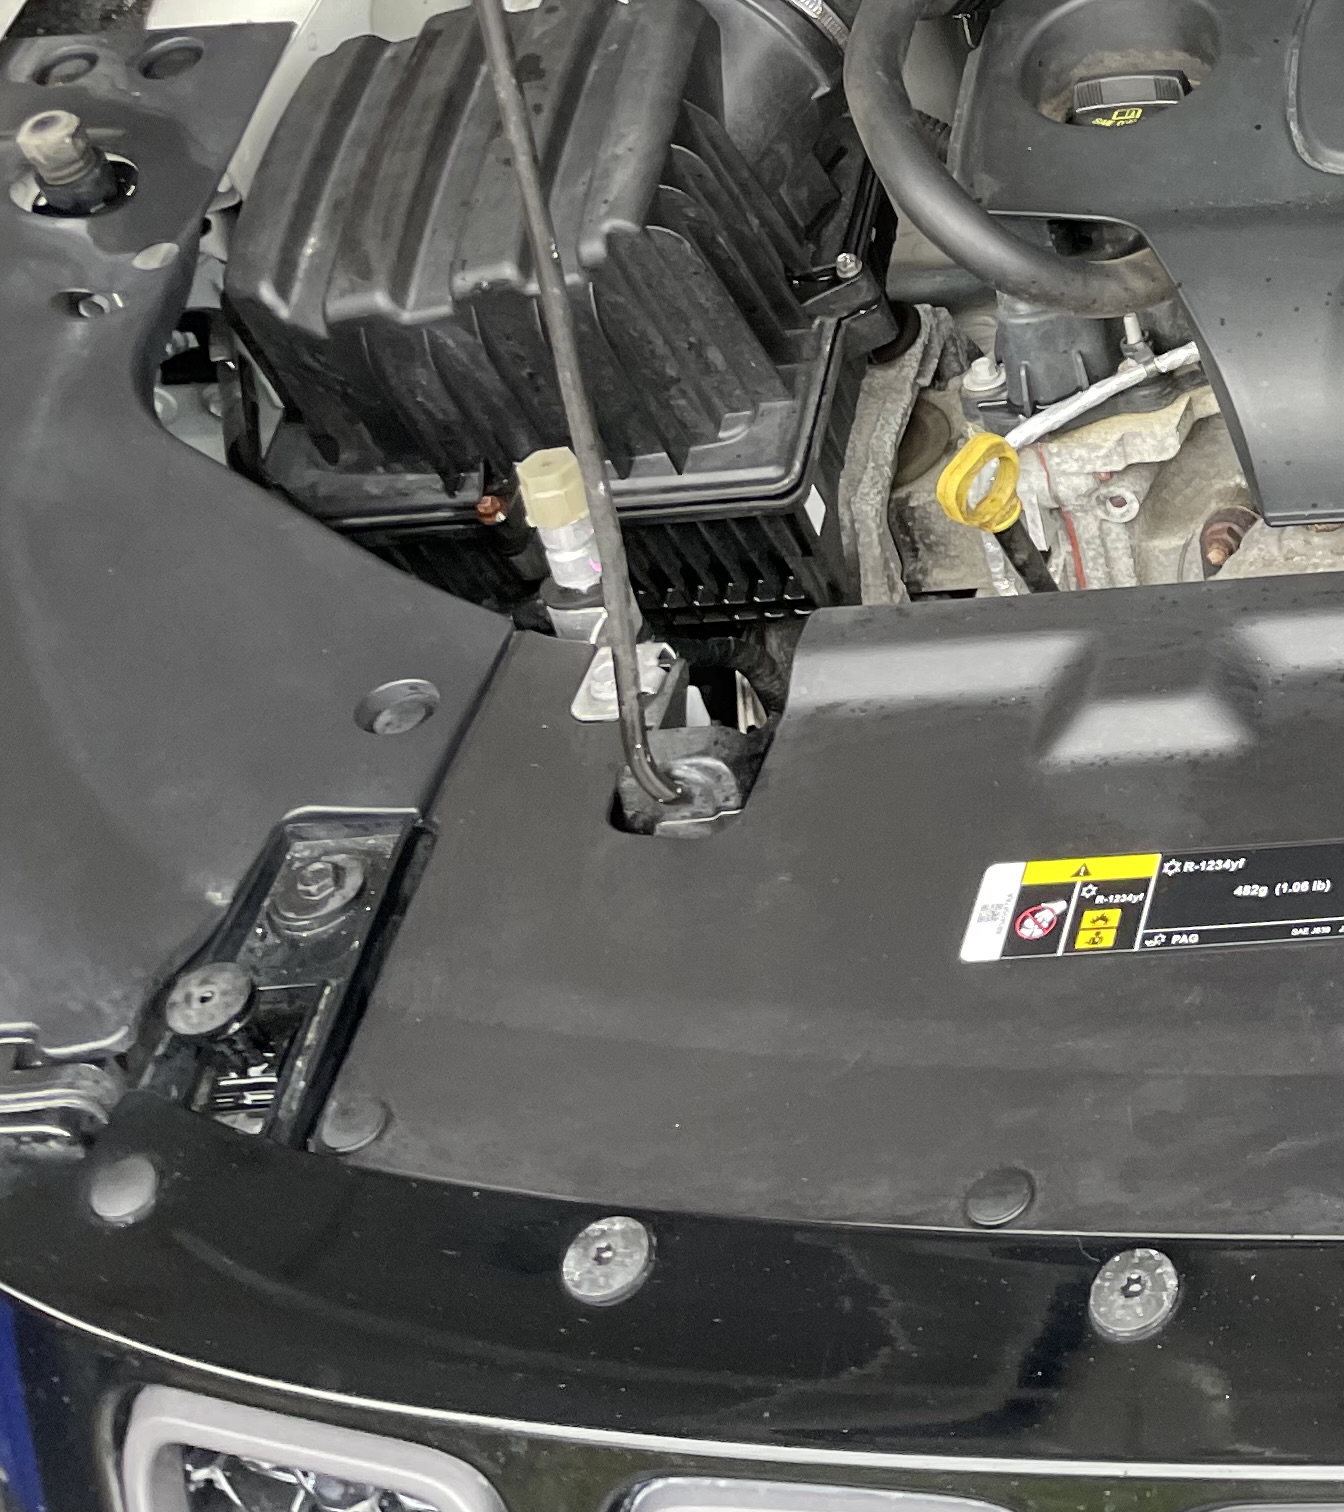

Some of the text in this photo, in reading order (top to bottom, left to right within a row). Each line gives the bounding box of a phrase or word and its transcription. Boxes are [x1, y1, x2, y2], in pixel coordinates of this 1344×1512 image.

[1182, 857, 1247, 875] R-1234yf
[1311, 879, 1333, 894] lb)
[1094, 892, 1146, 906] R-1234yf
[1170, 933, 1200, 945] PAG
